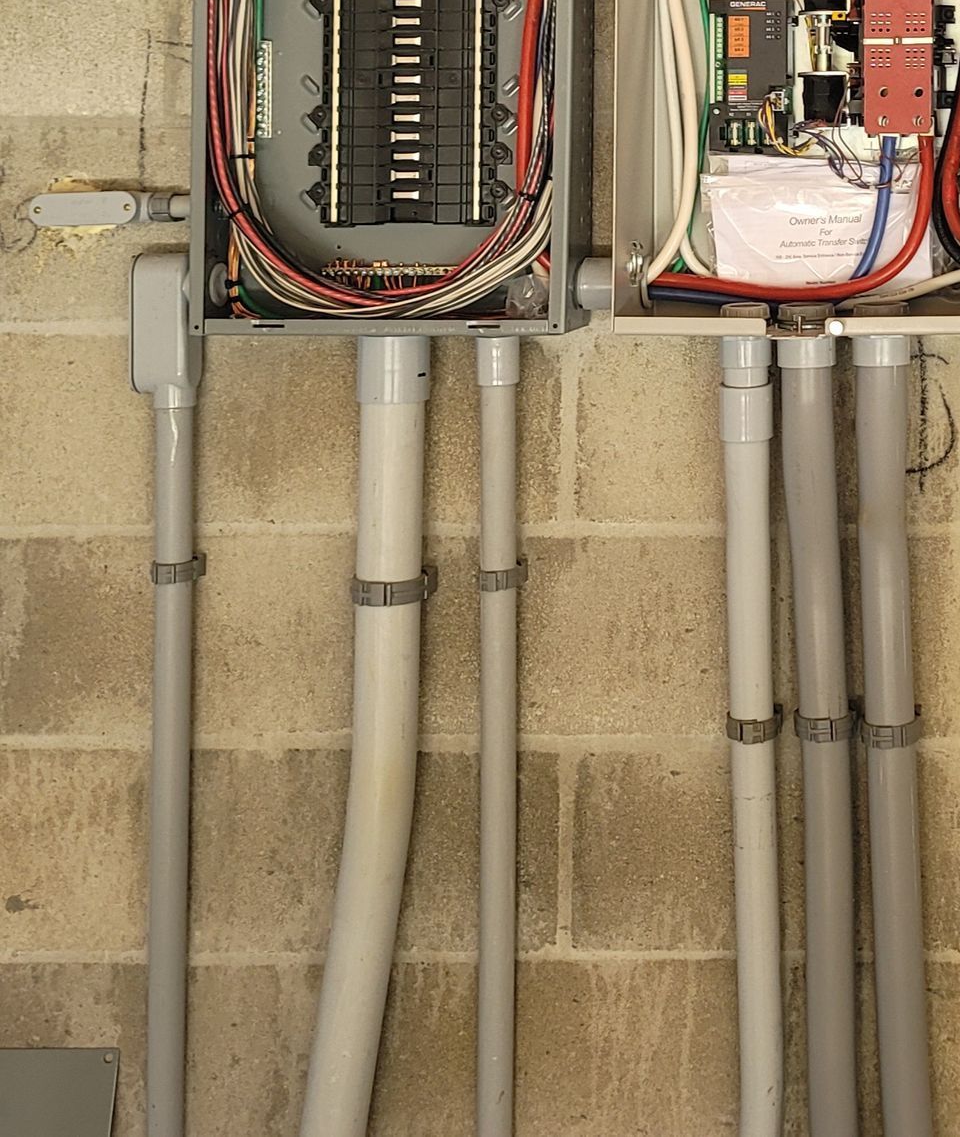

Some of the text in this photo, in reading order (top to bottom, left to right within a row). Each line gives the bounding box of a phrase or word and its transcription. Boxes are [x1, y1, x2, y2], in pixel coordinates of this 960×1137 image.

[789, 214, 862, 225] Owner's Manual
[819, 228, 832, 236] For
[779, 240, 815, 248] Automatic
[818, 238, 847, 247] Transfer
